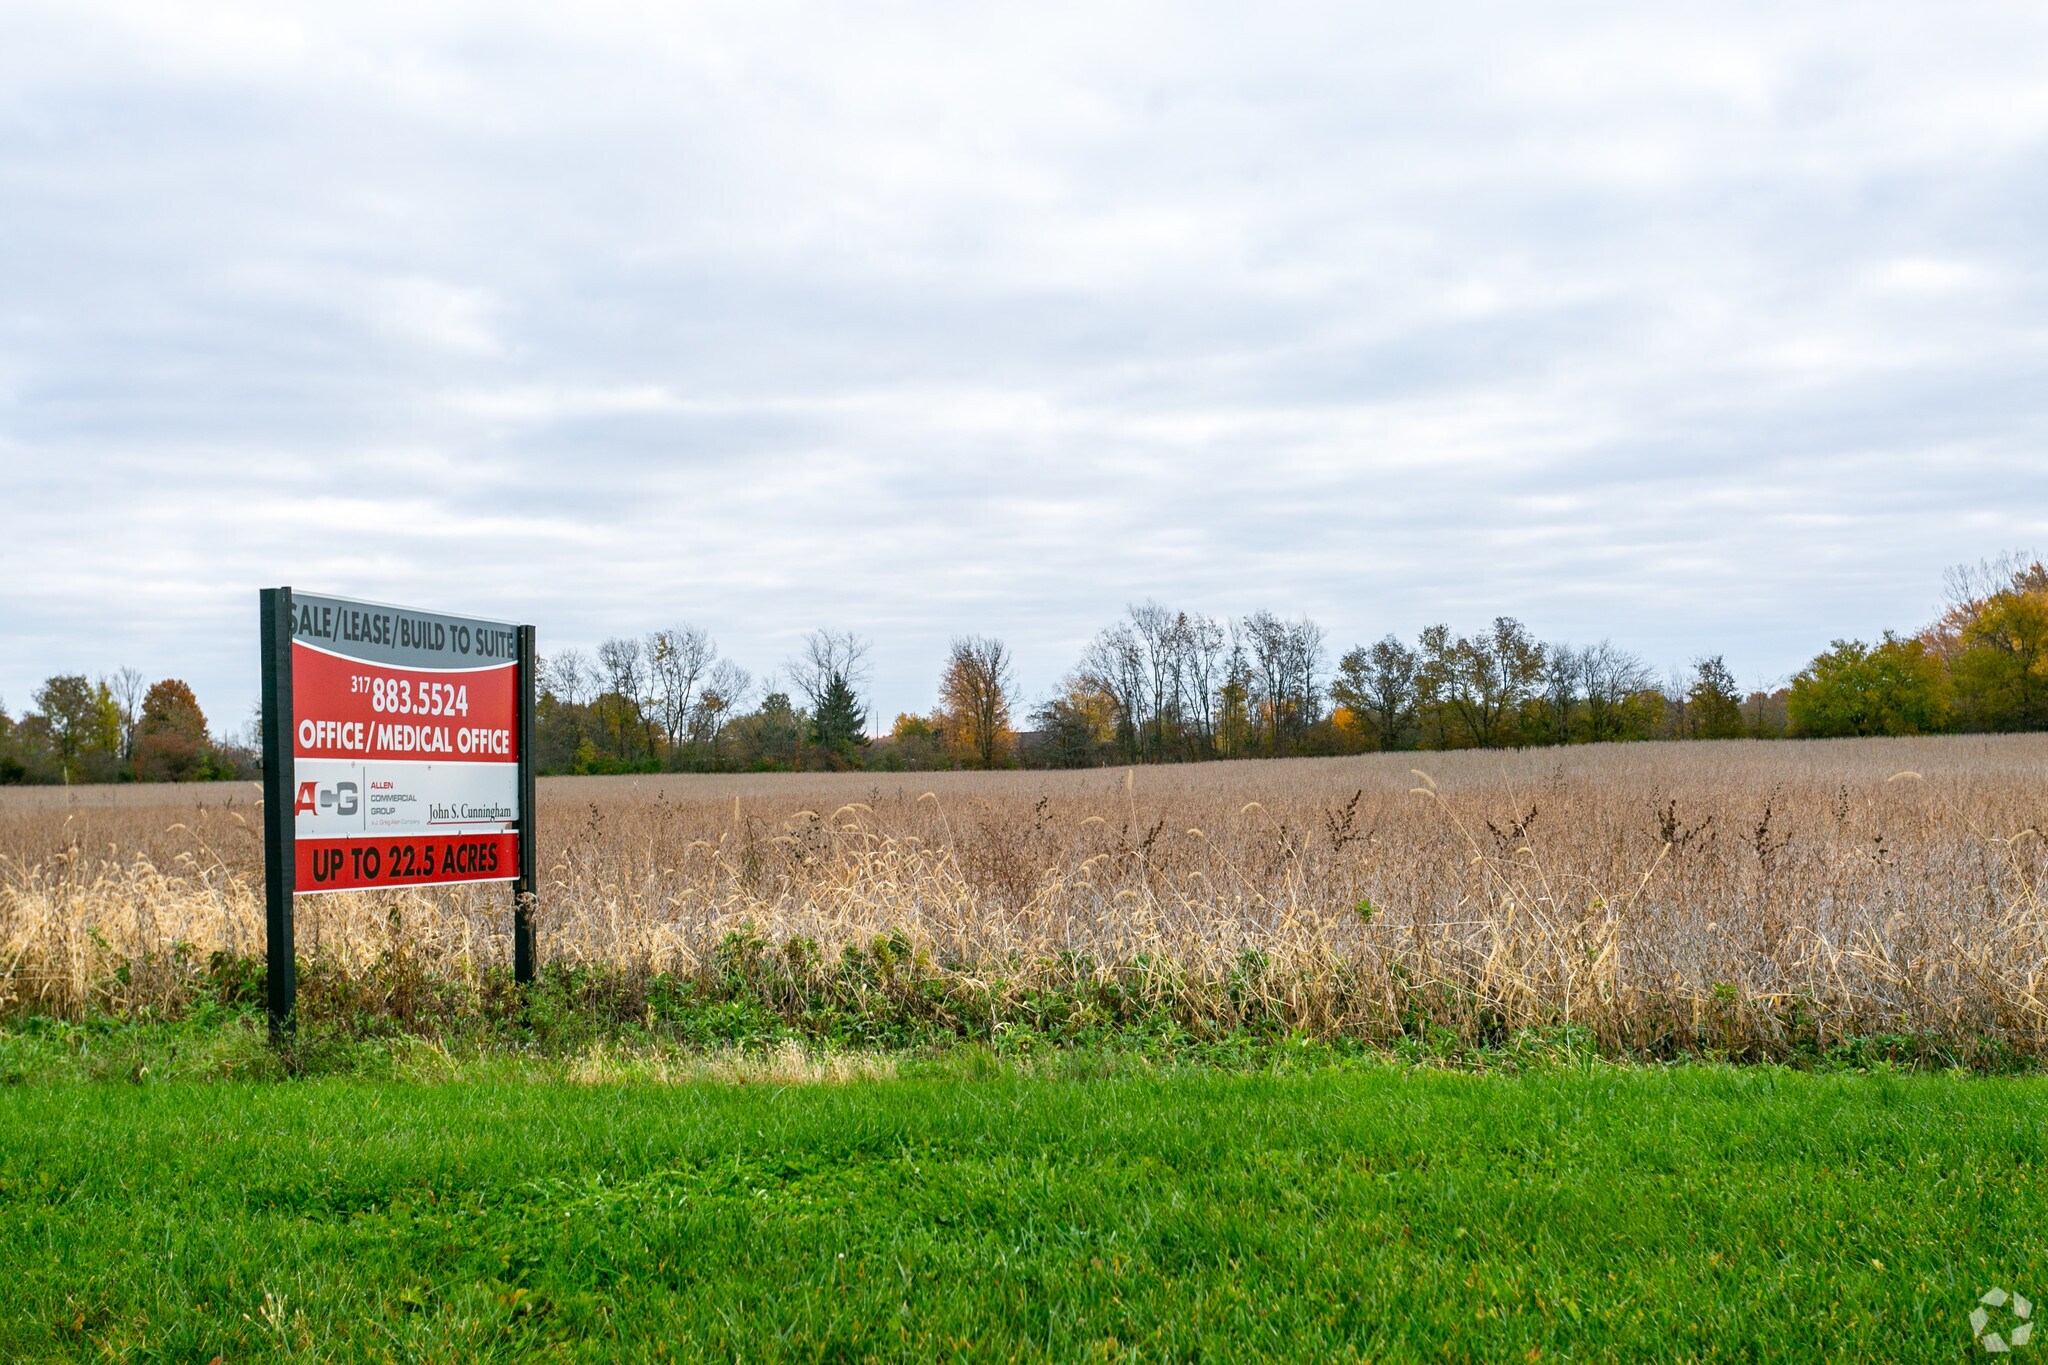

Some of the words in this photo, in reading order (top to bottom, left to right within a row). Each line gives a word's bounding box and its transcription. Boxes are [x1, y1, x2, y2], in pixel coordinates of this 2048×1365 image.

[449, 625, 470, 654] TO
[476, 627, 513, 658] SUITE
[351, 675, 370, 693] 317
[372, 677, 468, 717] 883.5524
[298, 719, 452, 753] OFFICE/MEDICAL
[457, 727, 509, 754] OFFICE
[371, 781, 393, 789] ALLEN
[371, 794, 417, 802] COMMERCIAL
[370, 807, 395, 815] GROUP
[428, 804, 449, 823] John
[451, 805, 459, 818] S.
[461, 802, 511, 823] Cunningham
[313, 848, 344, 882] UP
[351, 847, 381, 880] TO
[389, 845, 434, 878] 22.5
[442, 842, 498, 874] ACRES
